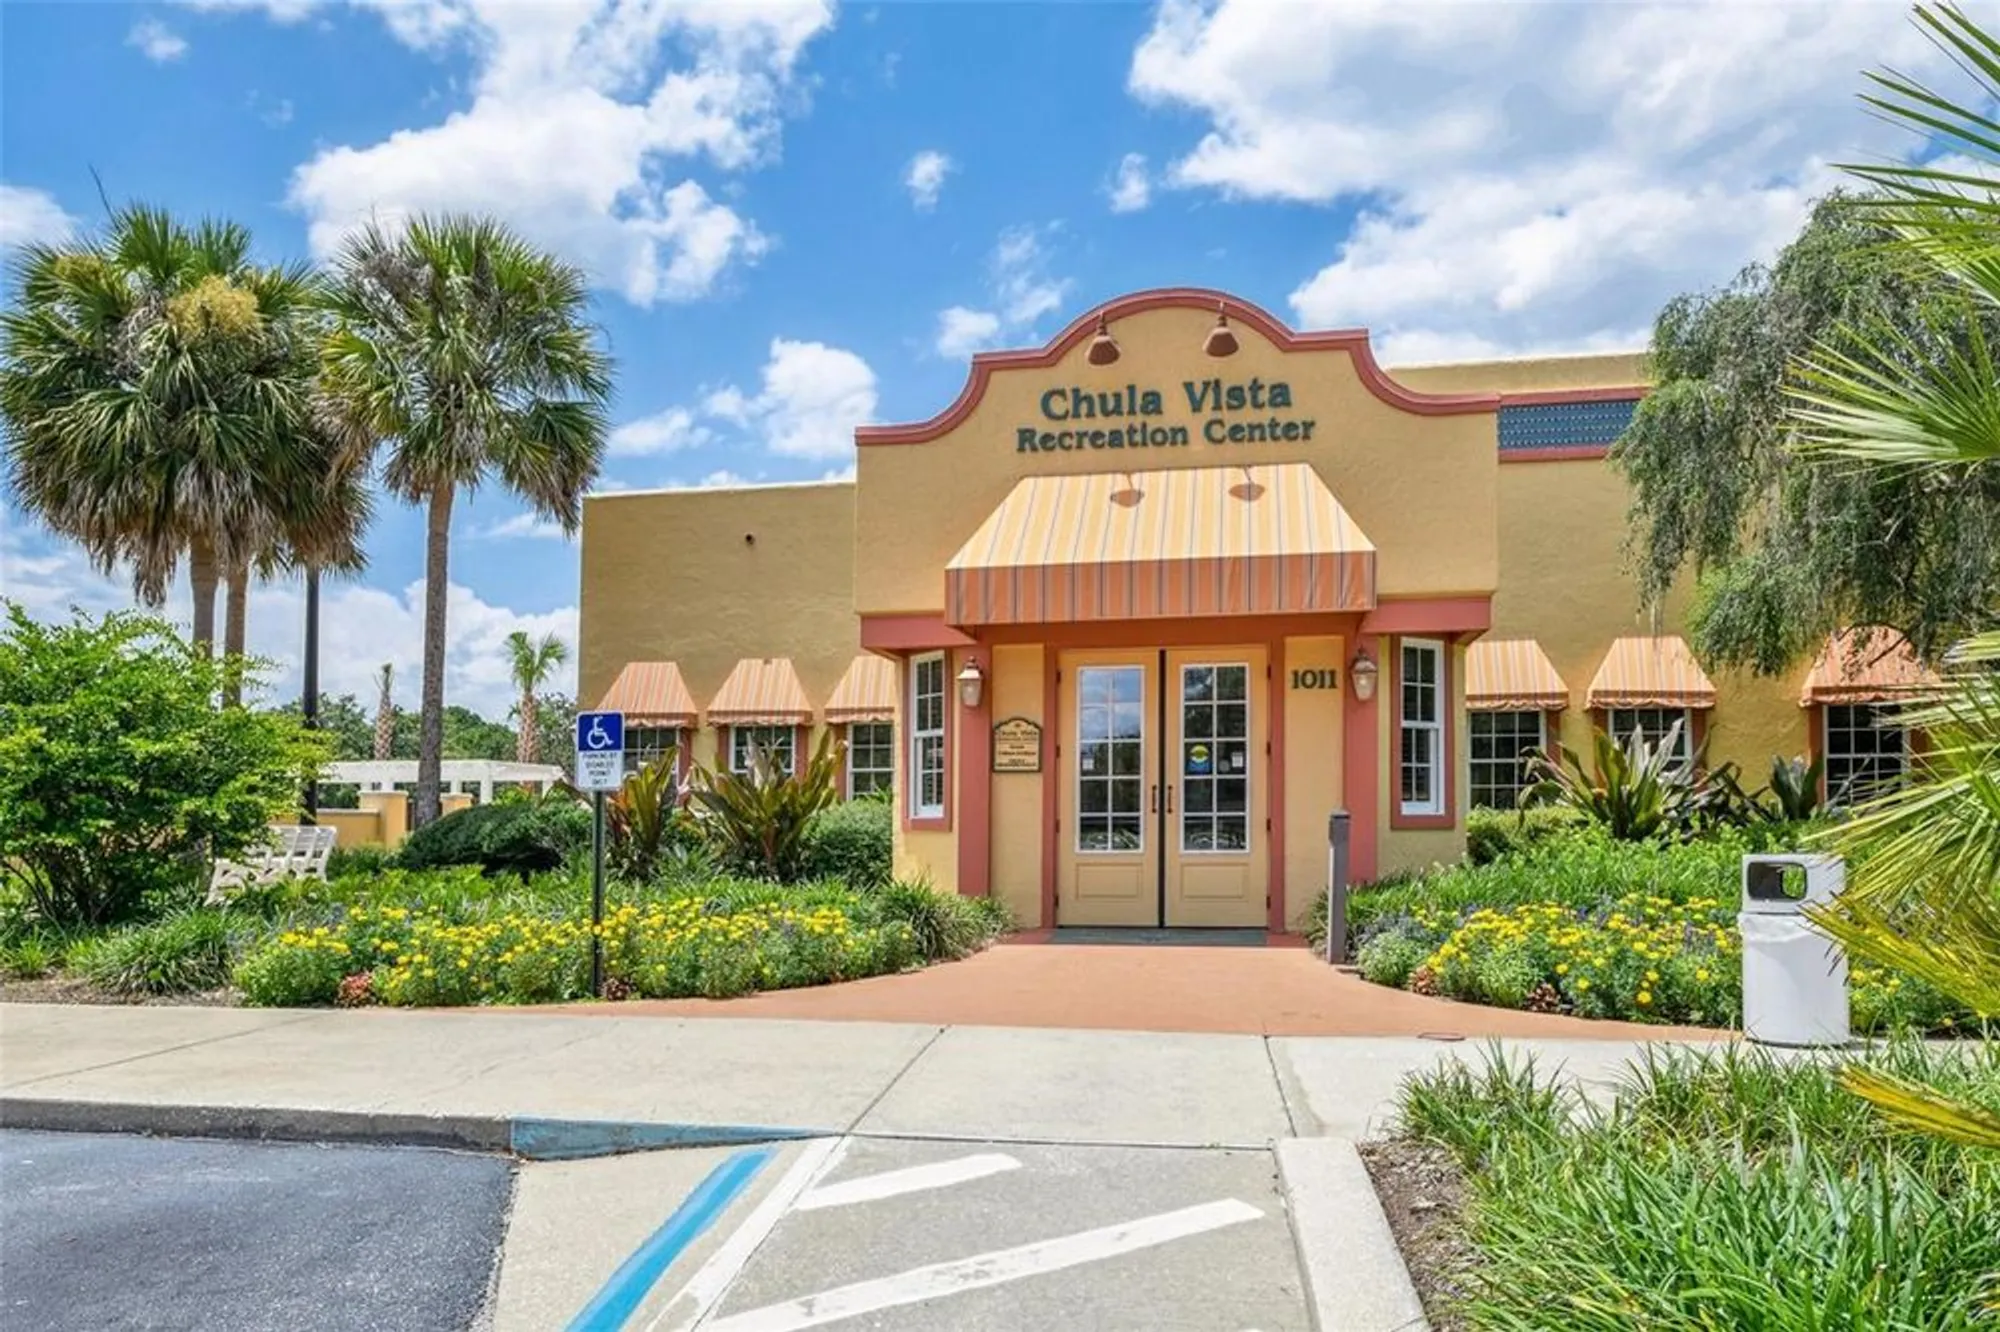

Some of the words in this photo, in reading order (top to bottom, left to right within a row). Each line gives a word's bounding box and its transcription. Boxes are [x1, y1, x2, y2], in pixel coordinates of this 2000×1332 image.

[1040, 384, 1163, 420] Chula
[1183, 378, 1292, 413] Vista
[1016, 422, 1189, 452] Recreation
[1203, 417, 1316, 444] Center
[1291, 668, 1338, 690] 1011
